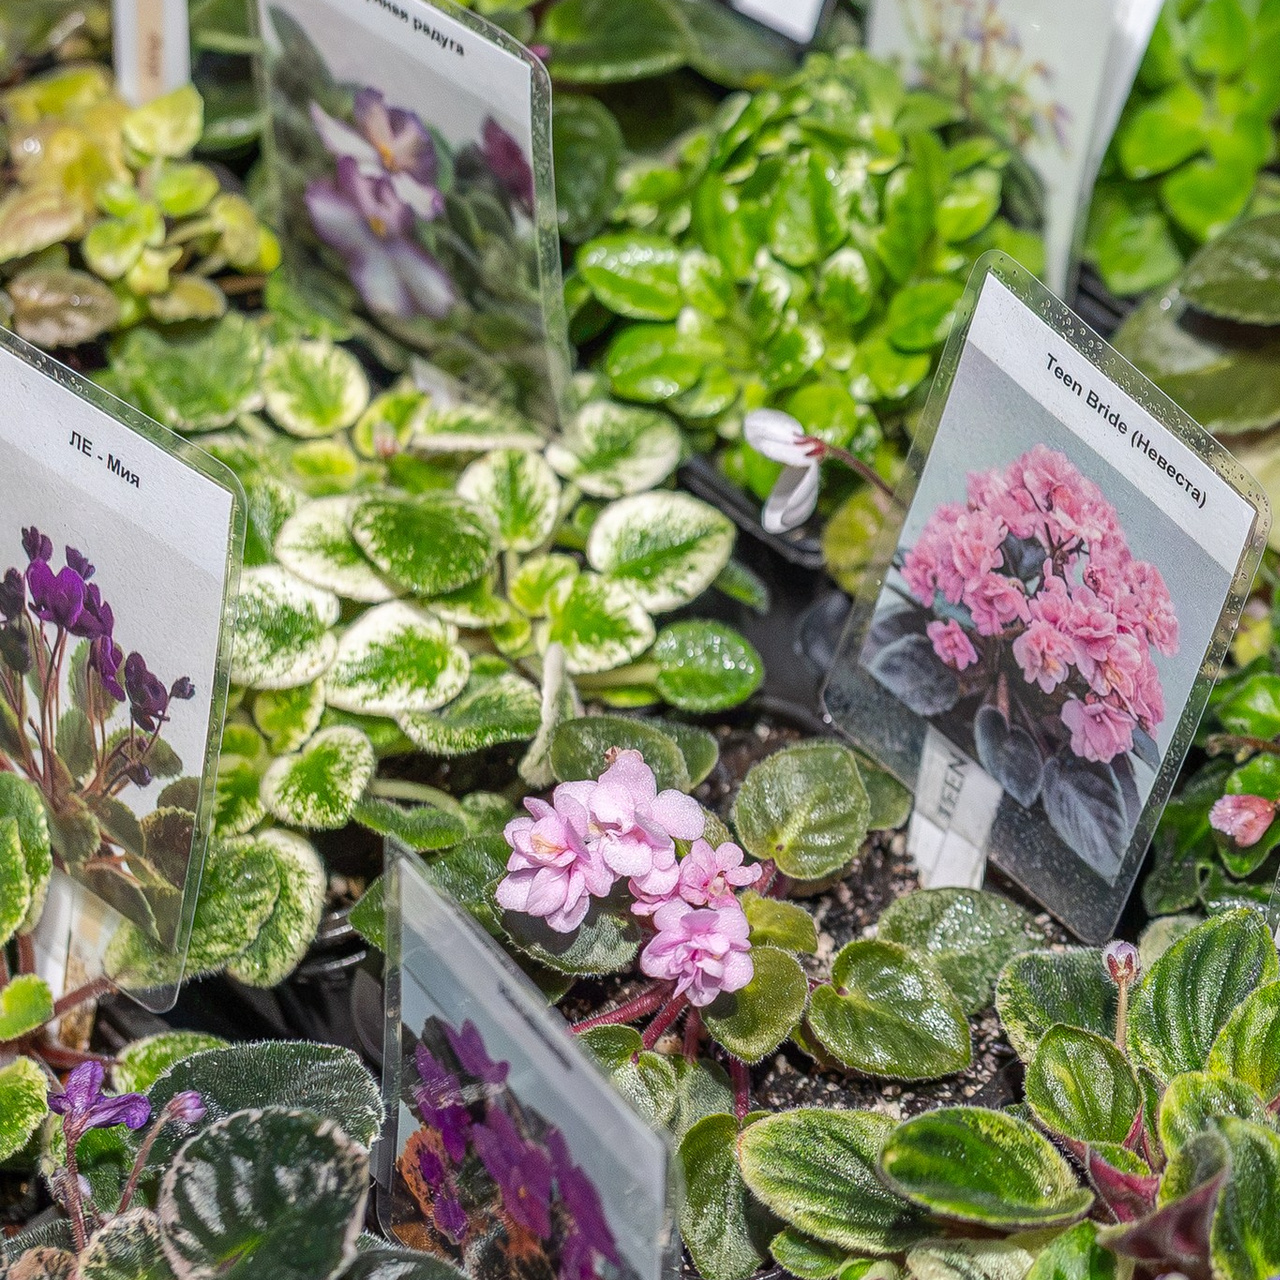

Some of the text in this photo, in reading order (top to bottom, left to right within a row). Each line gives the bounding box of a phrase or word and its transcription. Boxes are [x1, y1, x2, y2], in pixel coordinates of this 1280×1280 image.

[413, 17, 465, 56] радуга
[69, 430, 93, 458] ЛЕ
[107, 453, 140, 488] Мия
[1046, 353, 1207, 508] Teen Bride (Невеста)
